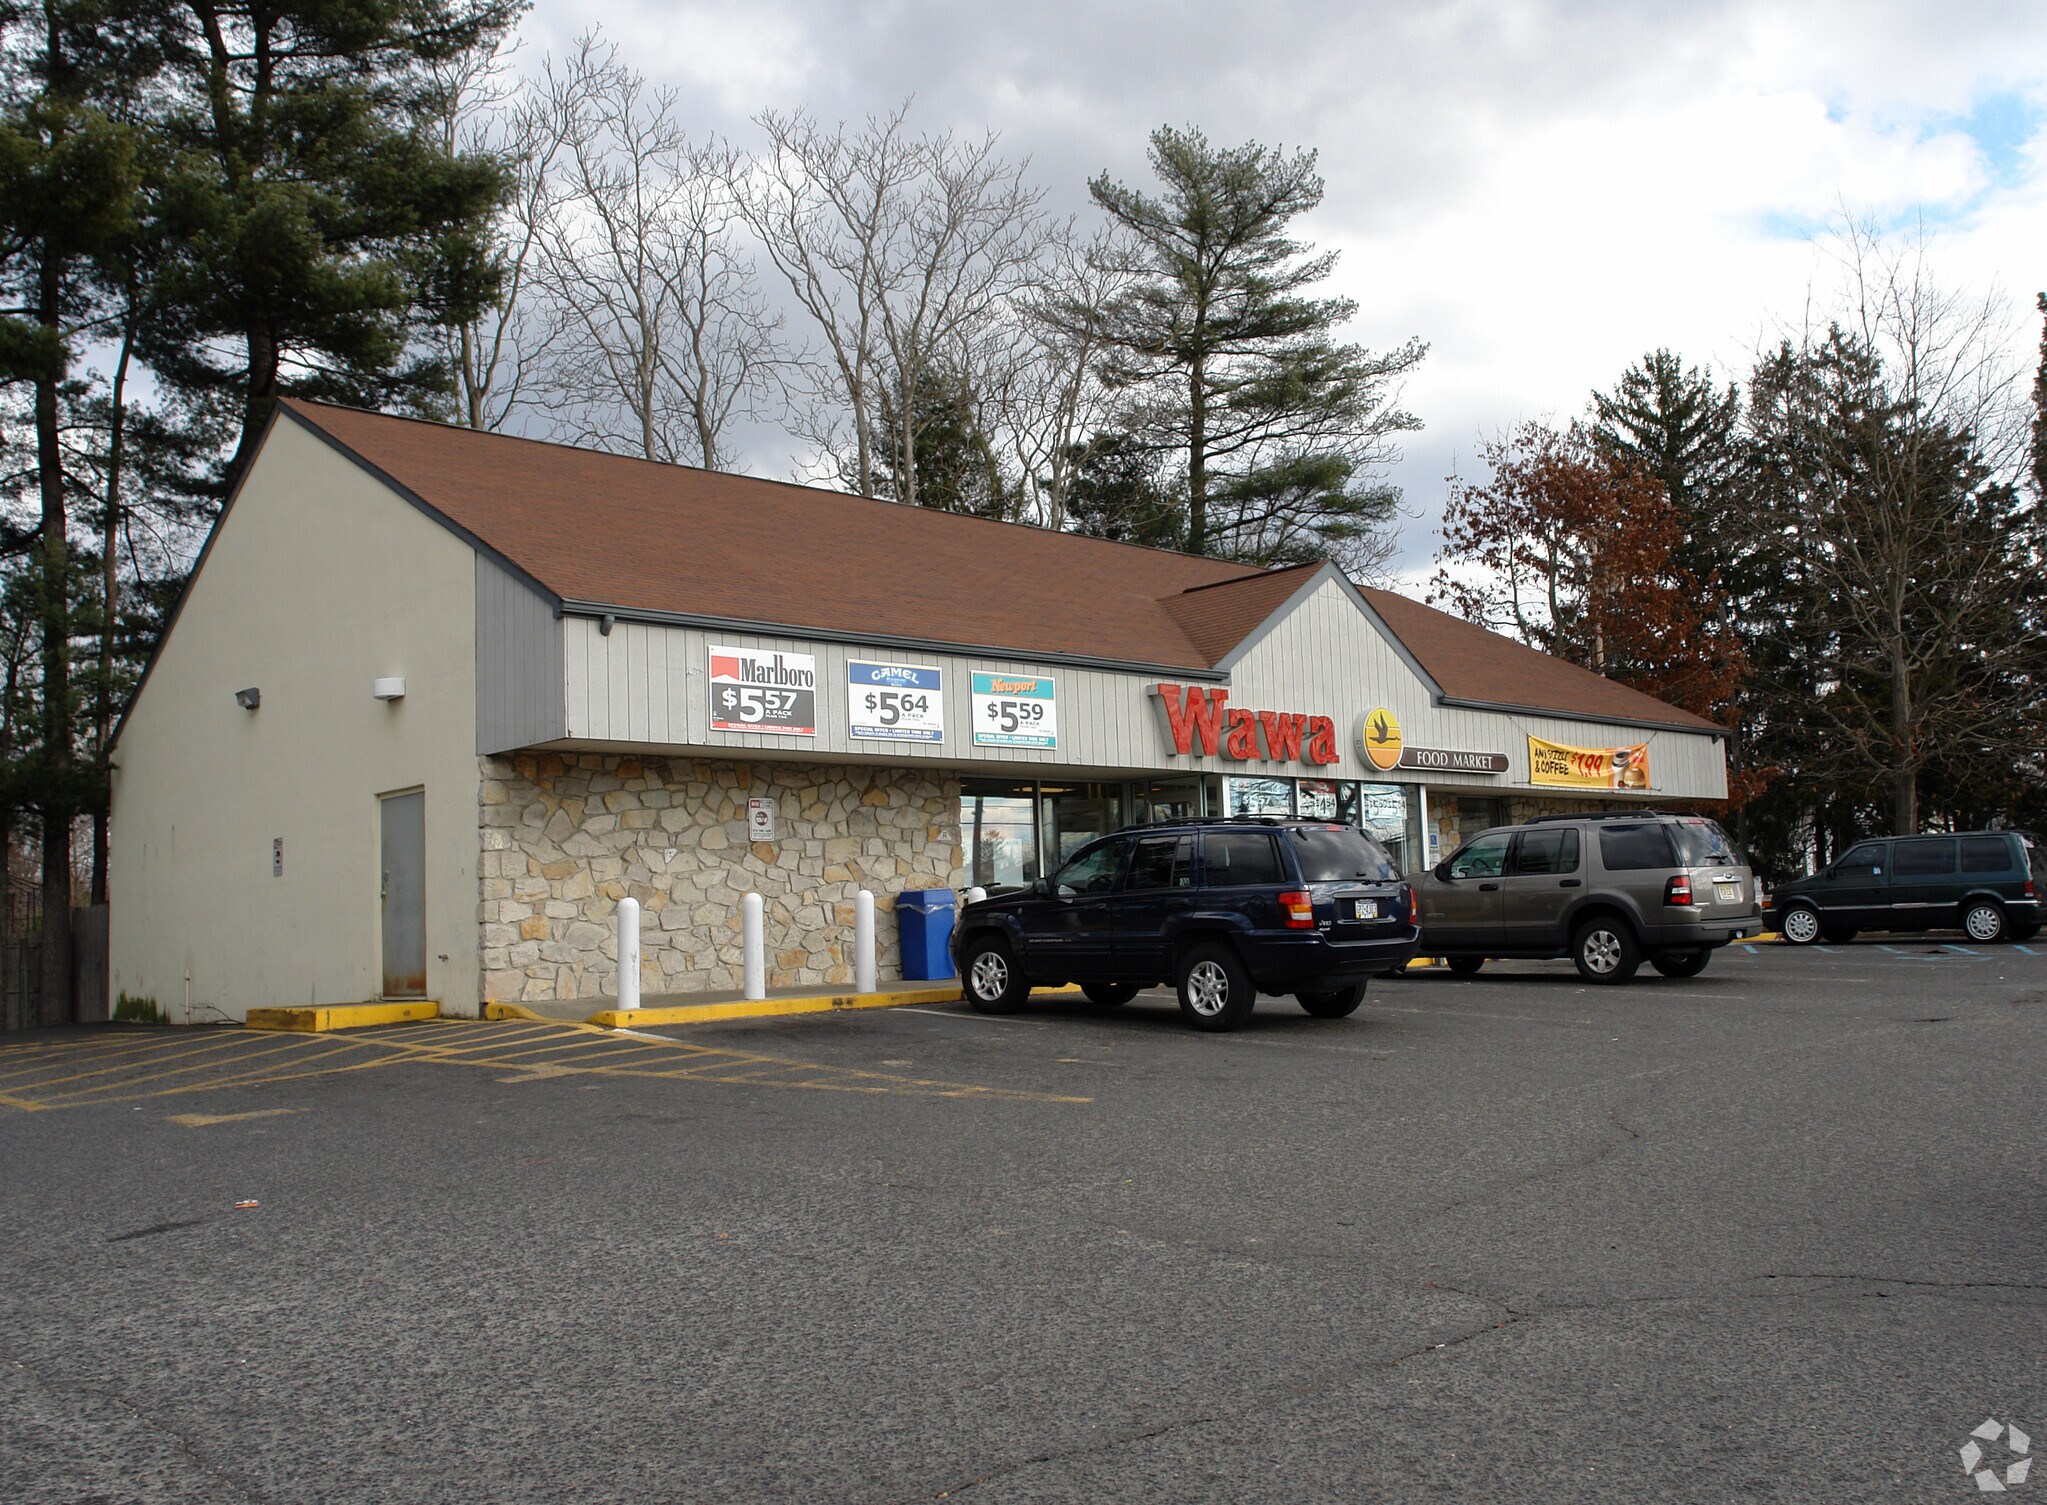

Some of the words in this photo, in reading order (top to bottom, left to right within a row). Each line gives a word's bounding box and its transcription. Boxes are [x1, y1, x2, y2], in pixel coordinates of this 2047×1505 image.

[741, 654, 814, 687] Marlboro
[871, 667, 920, 685] CAMEL
[991, 678, 1037, 694] Newport
[1148, 683, 1340, 765] Wawa
[1417, 751, 1449, 766] FOOD
[1452, 753, 1493, 769] MARKET
[1535, 747, 1547, 759] ANY
[1535, 760, 1540, 773] &
[1541, 760, 1569, 775] COFFEE
